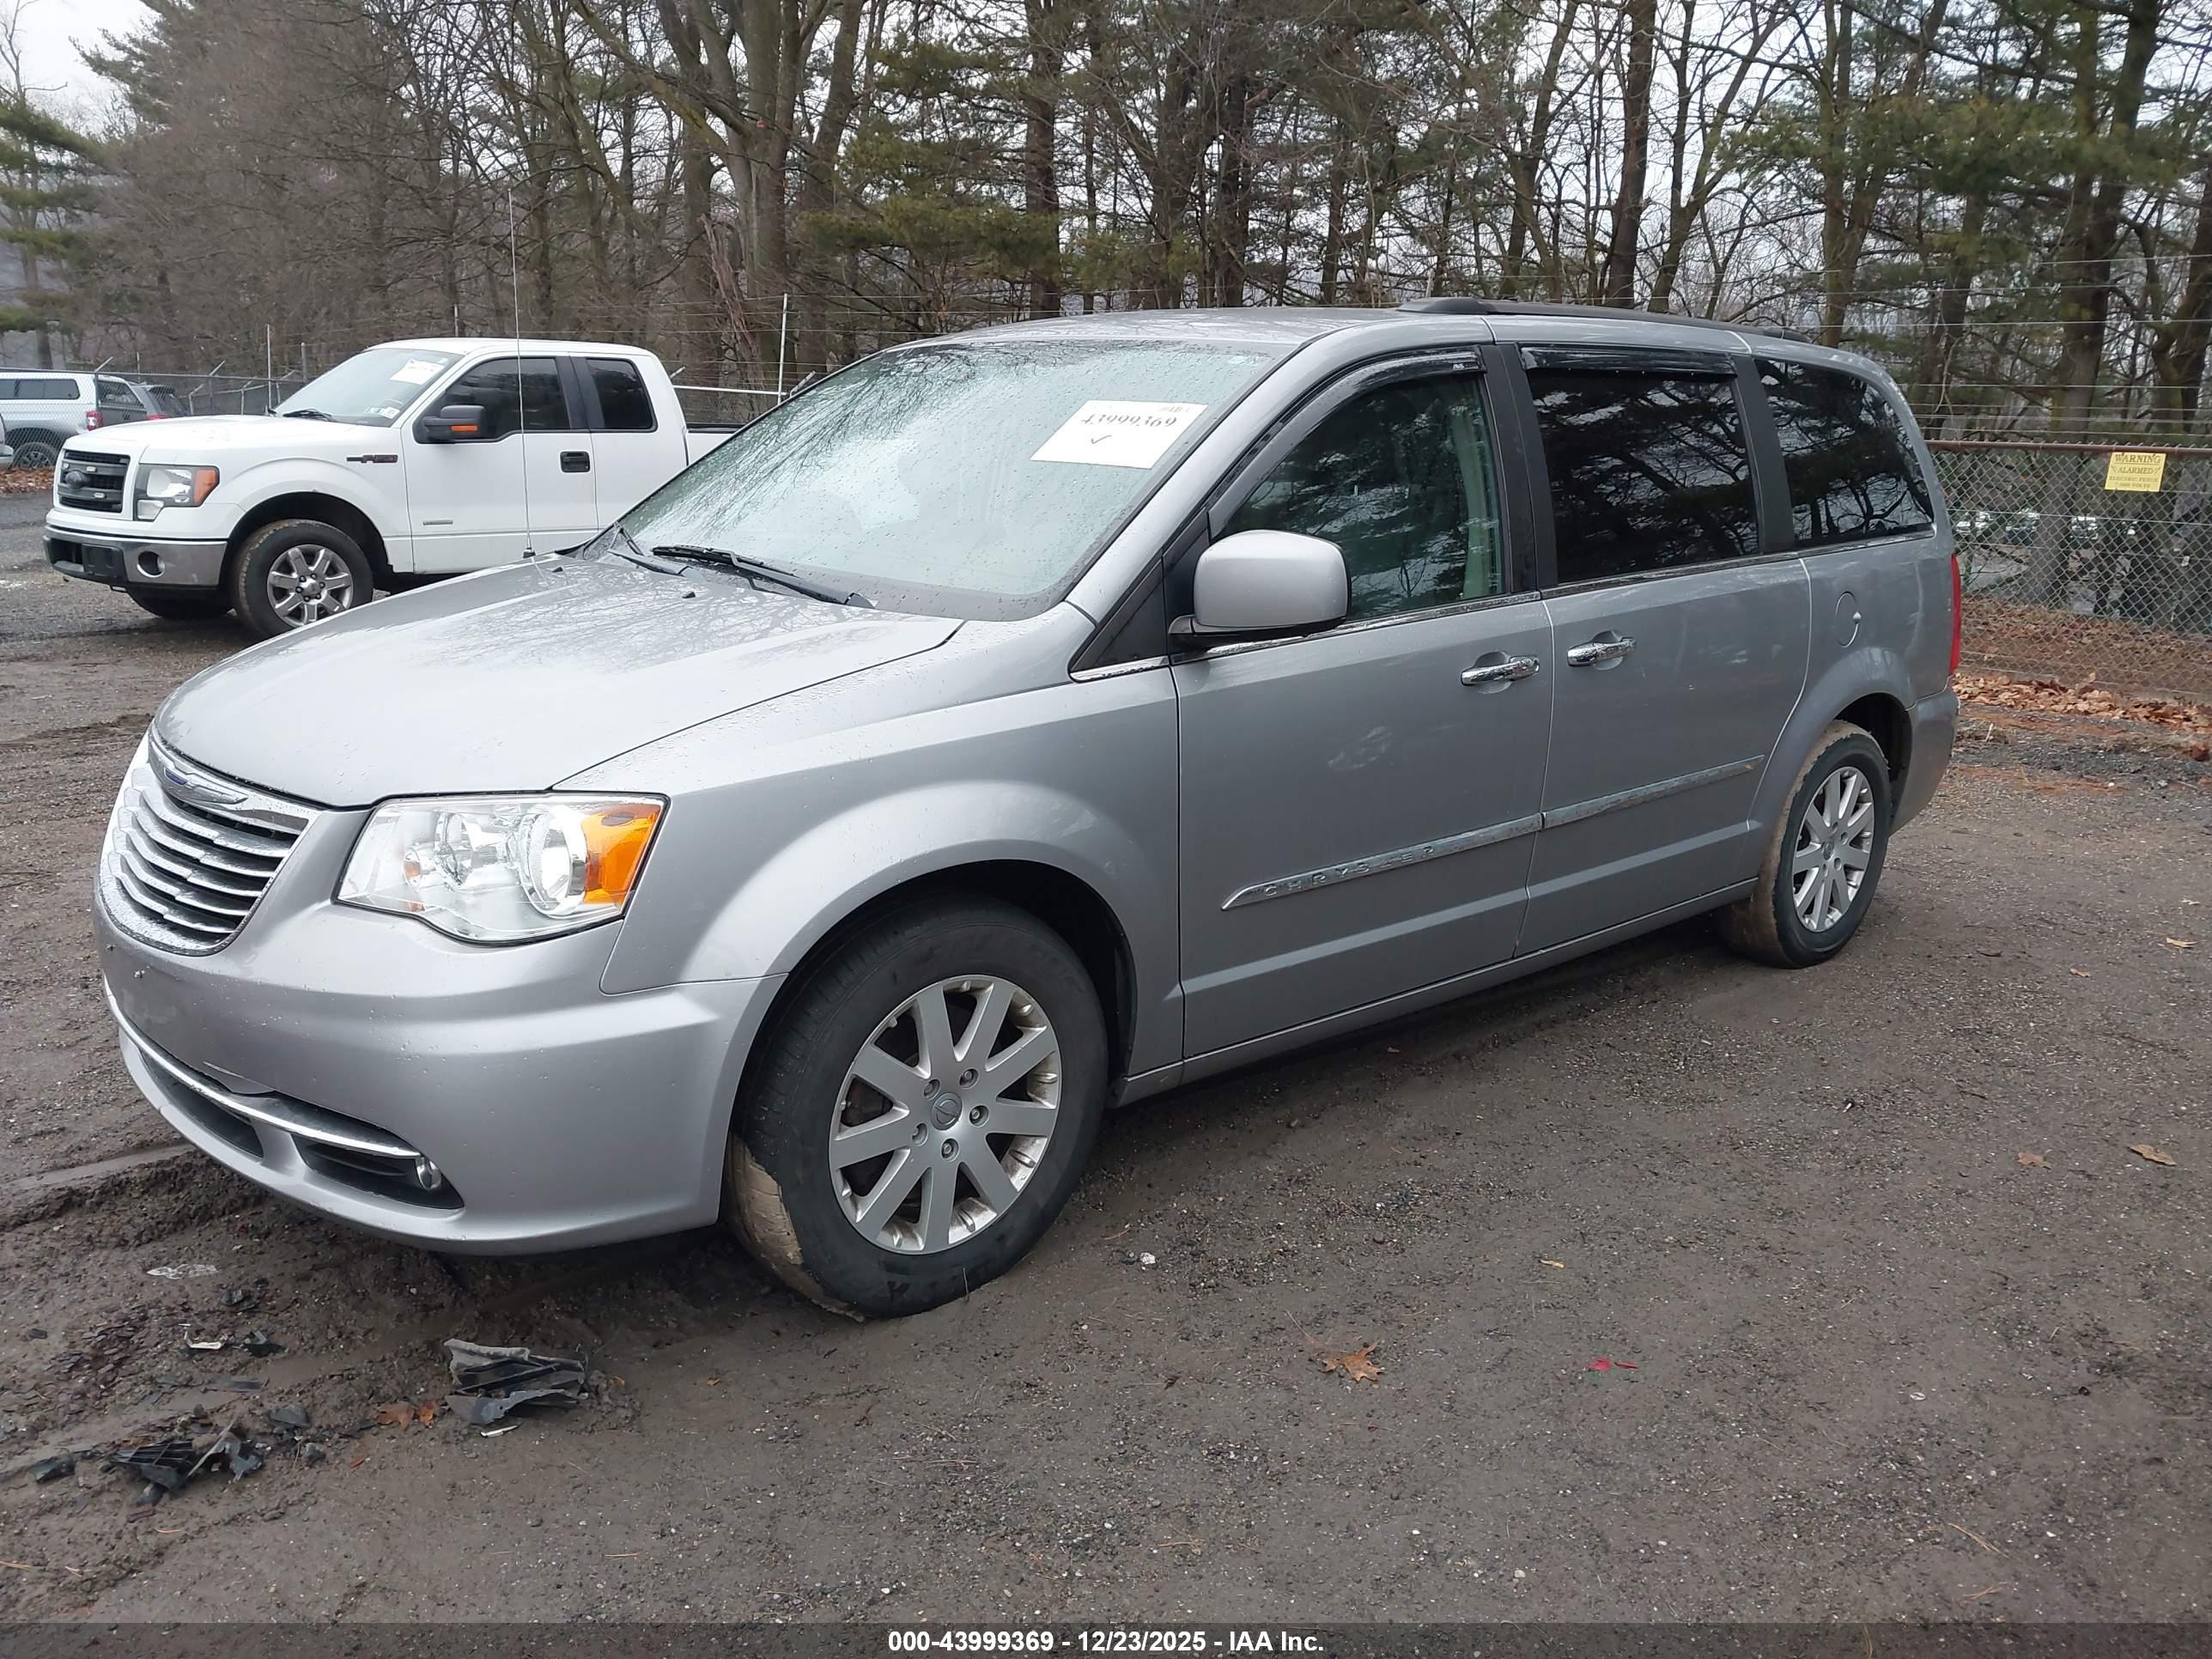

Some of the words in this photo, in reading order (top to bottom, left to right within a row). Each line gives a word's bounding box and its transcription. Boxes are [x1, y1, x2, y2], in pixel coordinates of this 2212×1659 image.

[1080, 413, 1177, 428] 43999369
[2115, 453, 2161, 464] WARNING
[2117, 466, 2154, 475] ALARMED
[1264, 845, 1435, 896] CHRYSLER
